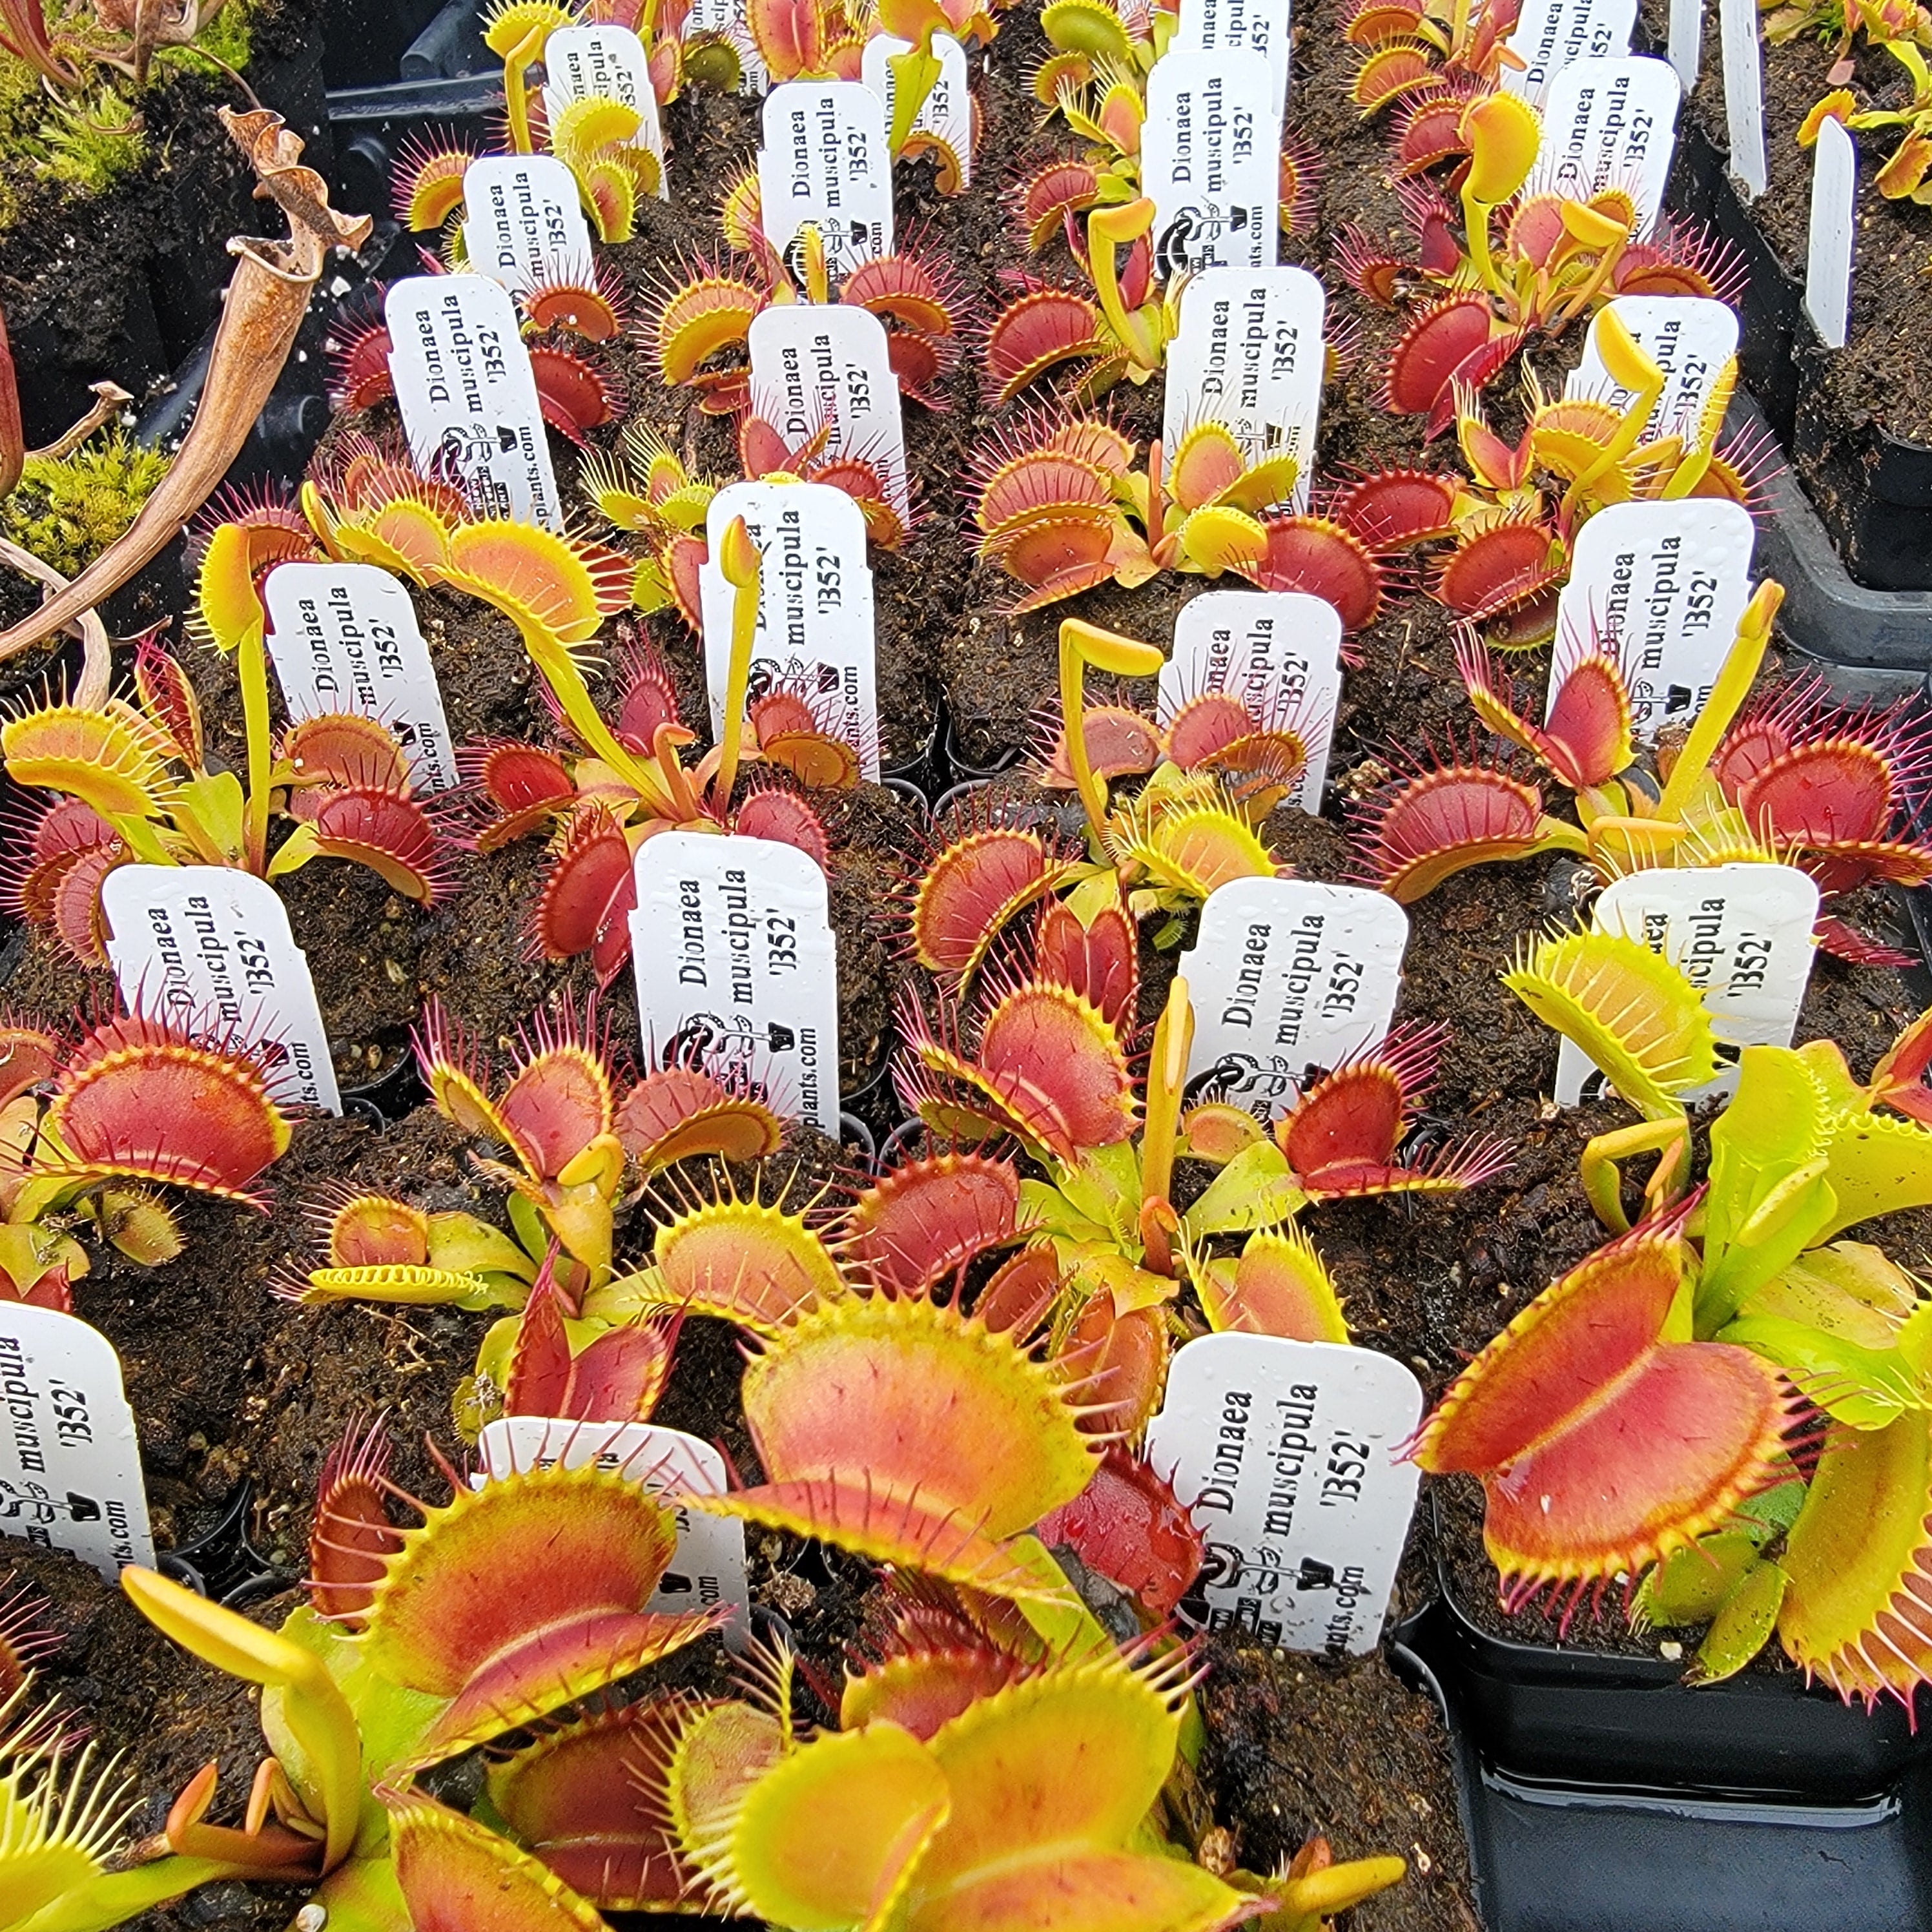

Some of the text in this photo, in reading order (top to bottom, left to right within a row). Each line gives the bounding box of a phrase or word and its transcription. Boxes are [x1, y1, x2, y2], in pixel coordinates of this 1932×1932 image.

[1527, 3, 1563, 84] Dionaea
[791, 110, 811, 198] Dionaea
[816, 98, 841, 208] muscipula
[1172, 92, 1191, 184] Dionaea
[1202, 77, 1227, 193] muscipula
[1557, 88, 1595, 180] Dionaea
[1593, 77, 1630, 192] muscipula
[490, 185, 516, 269] Dionaea
[513, 172, 544, 277] muscipula
[416, 309, 450, 404] Dionaea
[442, 294, 483, 414] muscipula
[782, 347, 807, 435] Dionaea
[1202, 301, 1229, 396] Dionaea
[1240, 288, 1268, 409] muscipula
[777, 510, 808, 646] muscipula
[1598, 552, 1635, 655] Dionaea
[1641, 536, 1681, 670] muscipula
[299, 599, 340, 694] Dionaea
[328, 587, 377, 706] muscipula
[148, 907, 196, 1009] Dionaea
[185, 896, 242, 1023] muscipula
[677, 879, 707, 989] Dionaea
[719, 869, 757, 1005] muscipula
[1221, 923, 1272, 1029] Dionaea
[1275, 914, 1325, 1046] muscipula
[1197, 1390, 1253, 1514] Dionaea
[1263, 1383, 1318, 1537] muscipula
